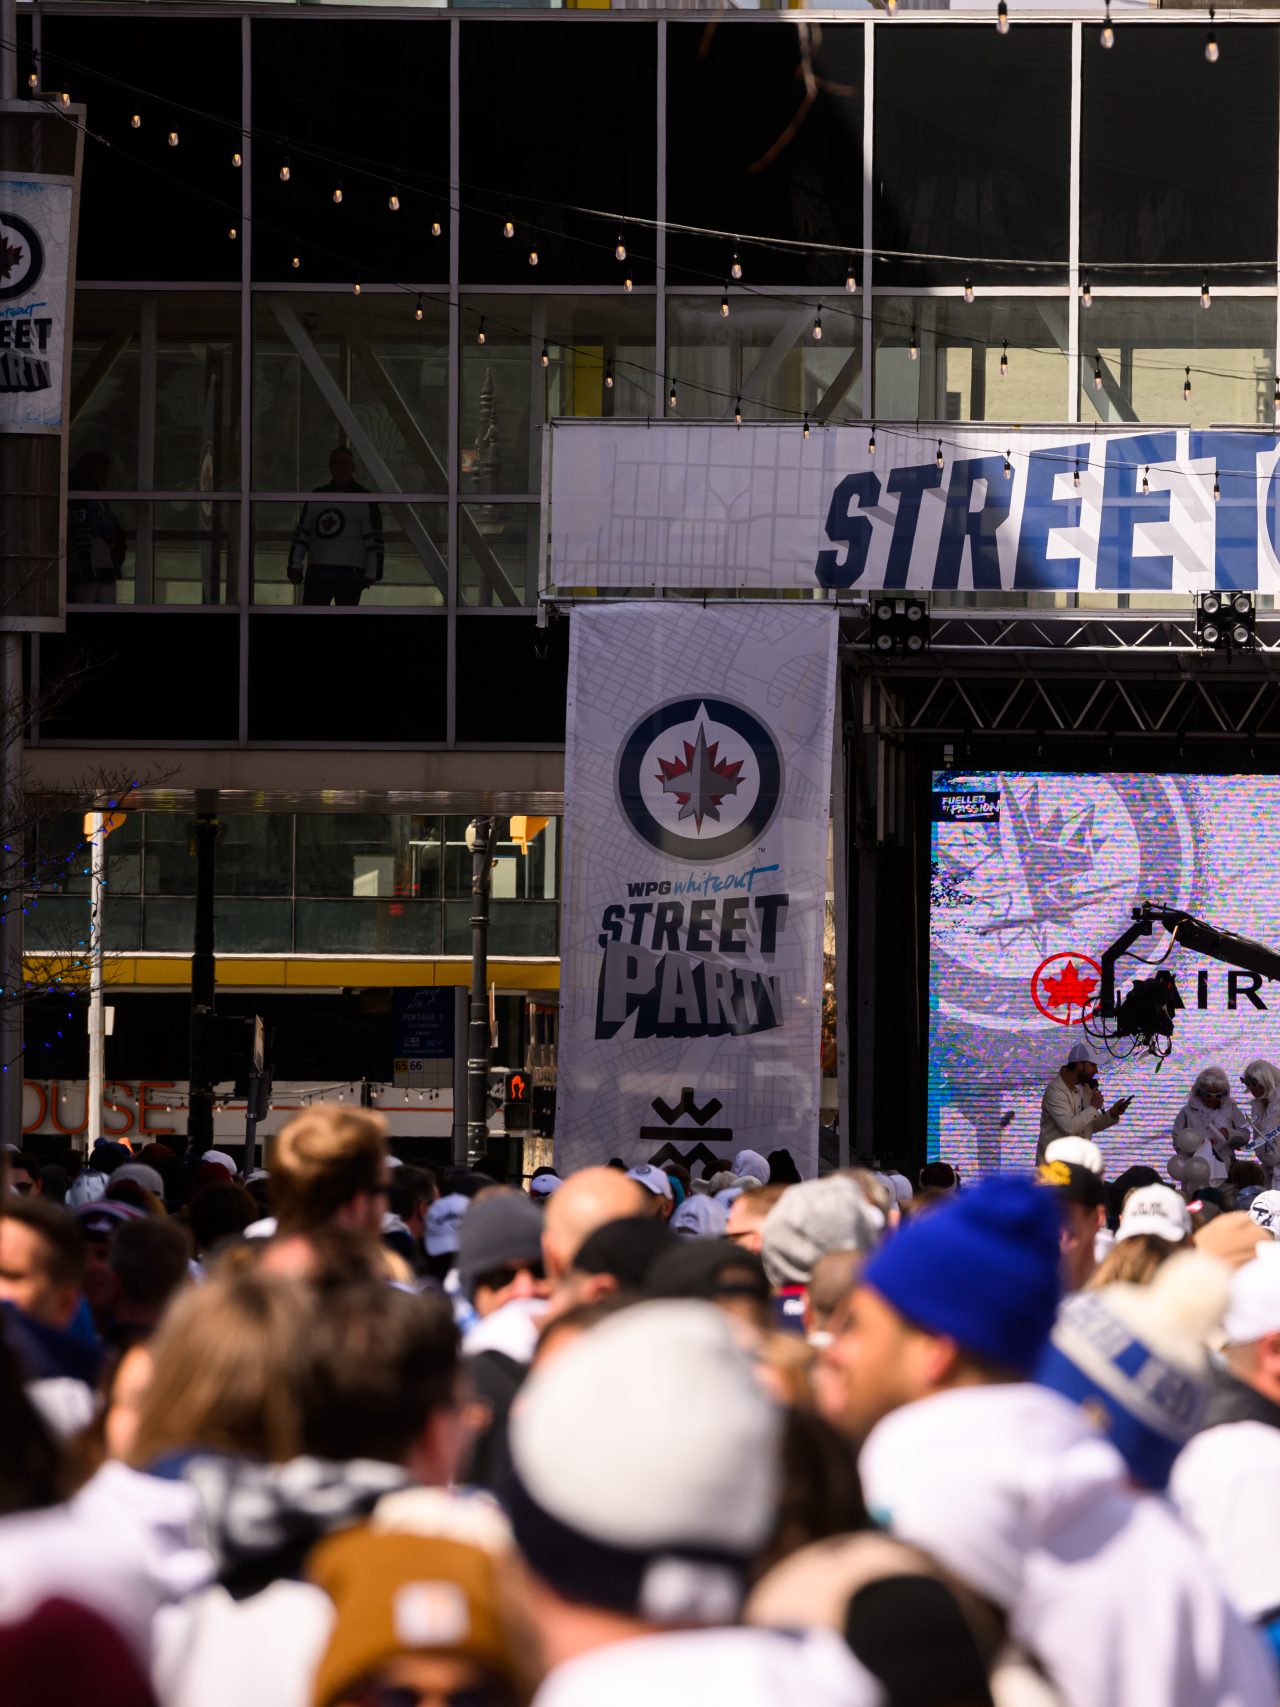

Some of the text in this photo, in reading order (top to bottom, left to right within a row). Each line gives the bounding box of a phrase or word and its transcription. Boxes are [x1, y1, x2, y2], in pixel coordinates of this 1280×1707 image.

[941, 795, 987, 805] FUELLED
[950, 800, 1000, 815] PASSION
[626, 863, 780, 898] WPG whiteout
[597, 893, 790, 954] STREET
[595, 938, 785, 1040] PARTY
[395, 1061, 422, 1071] 65 66
